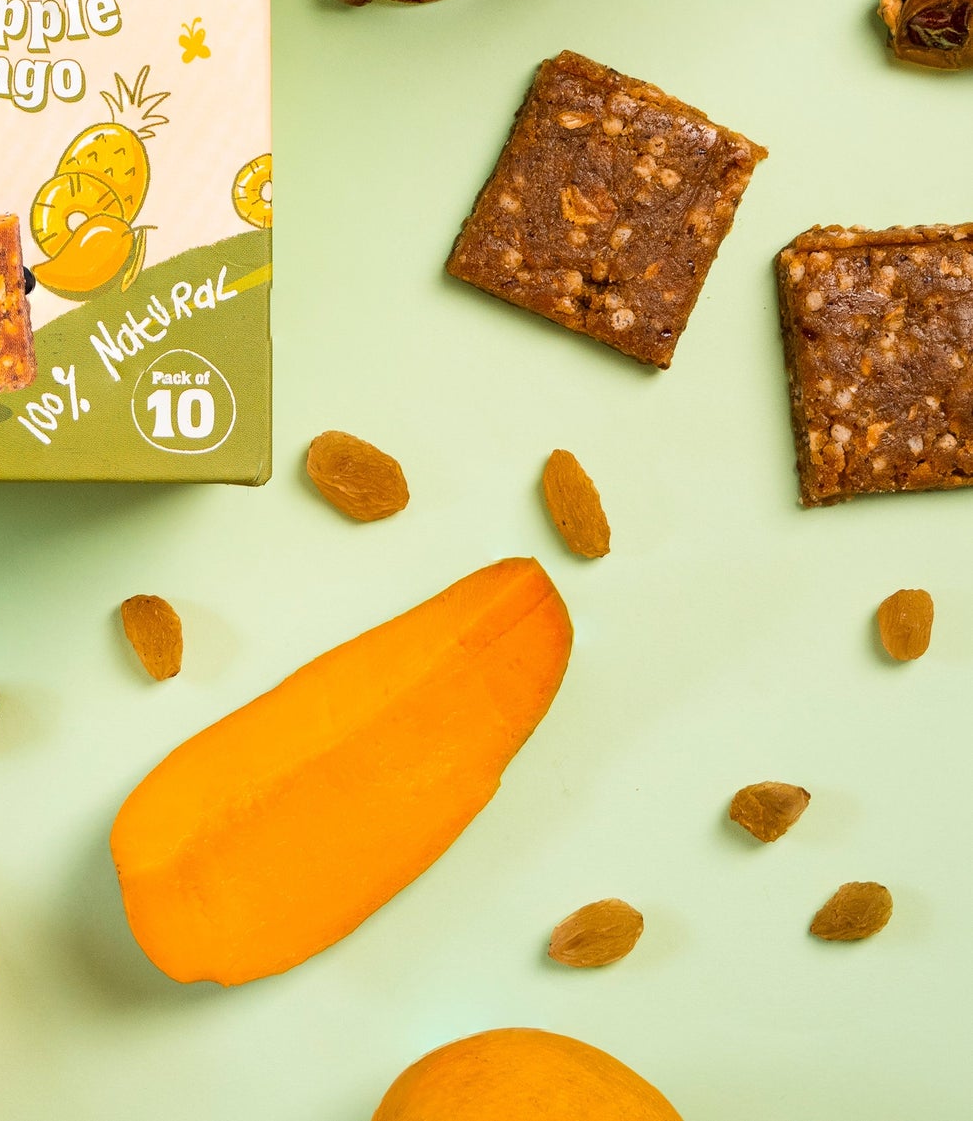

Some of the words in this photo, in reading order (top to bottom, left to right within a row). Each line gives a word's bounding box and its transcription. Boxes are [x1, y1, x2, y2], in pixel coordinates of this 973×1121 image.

[151, 370, 192, 385] Pack
[194, 370, 211, 385] of
[17, 364, 91, 445] 100%
[147, 388, 215, 439] 10
